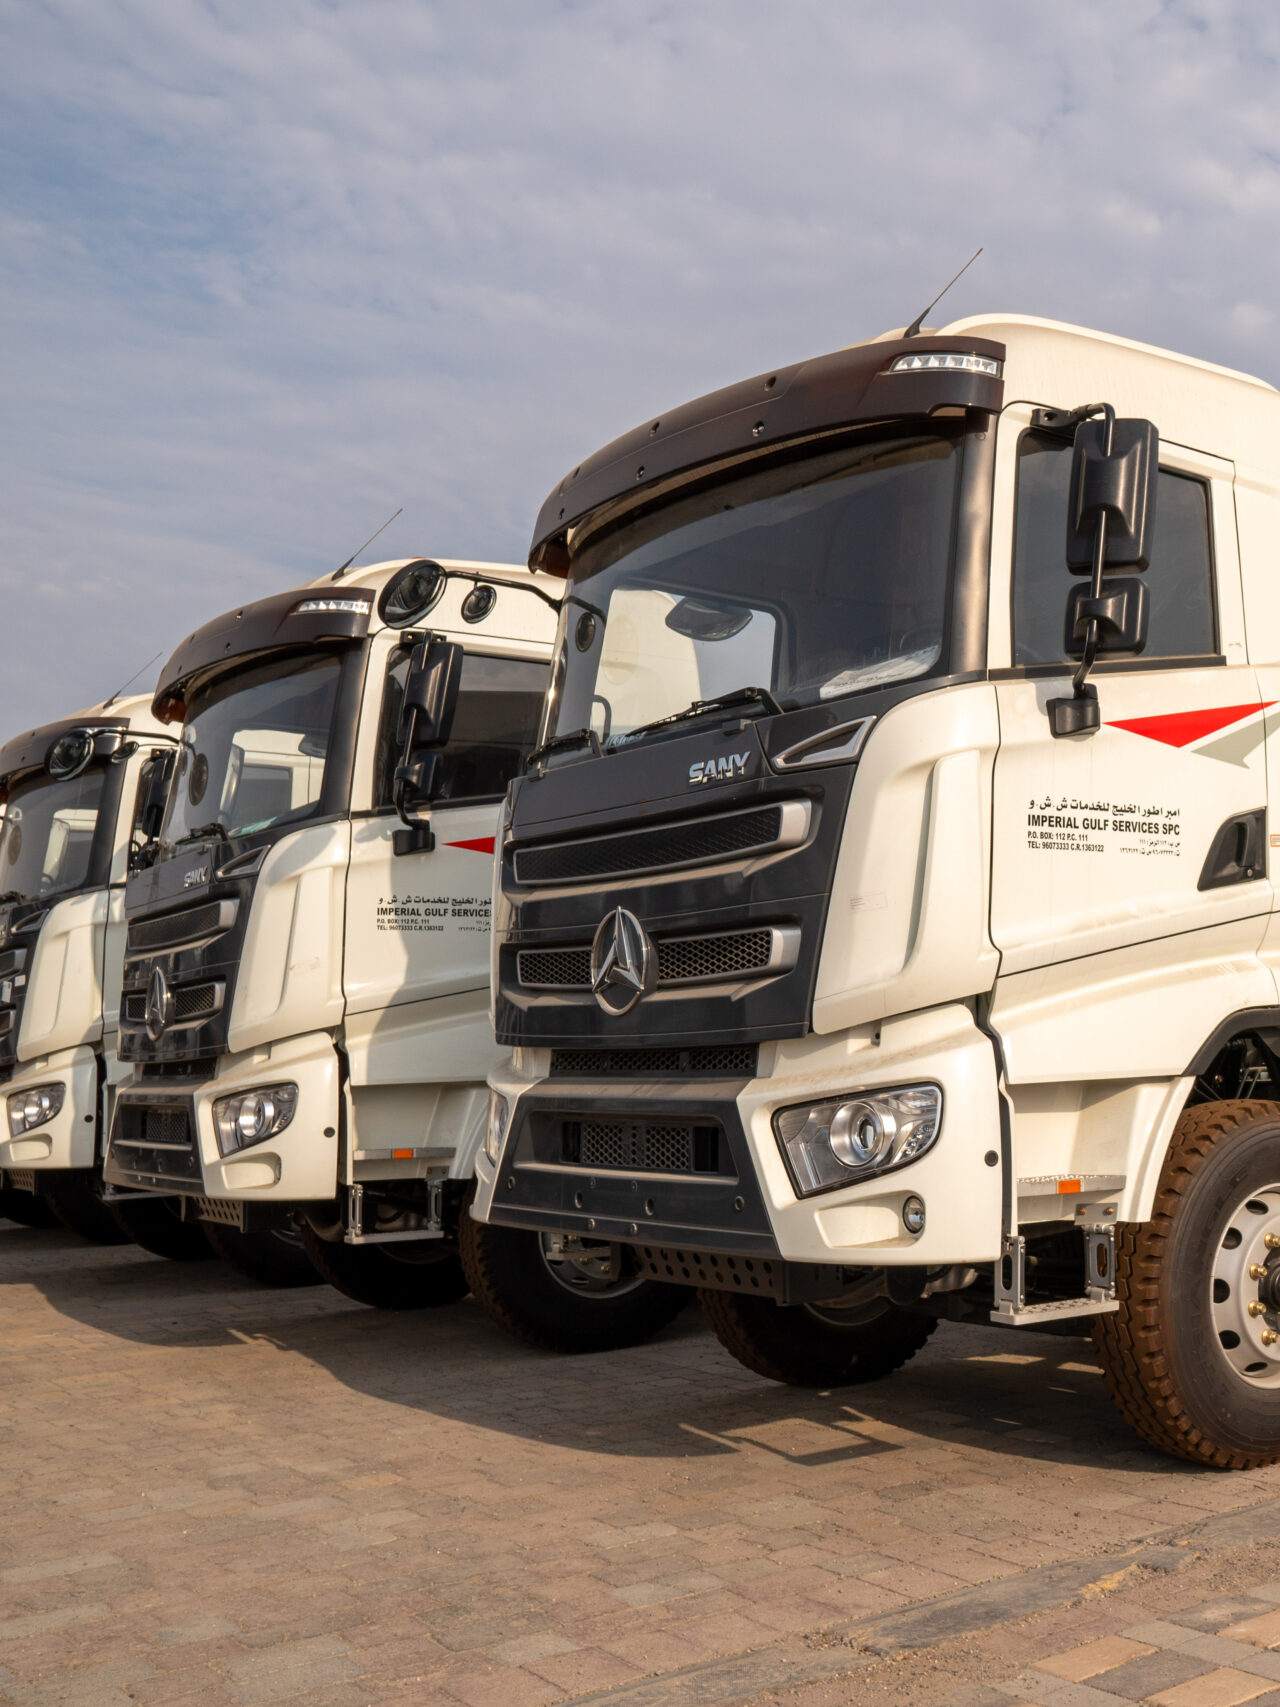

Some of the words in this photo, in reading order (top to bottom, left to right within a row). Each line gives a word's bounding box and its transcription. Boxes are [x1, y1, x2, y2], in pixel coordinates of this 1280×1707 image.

[689, 751, 751, 783] SANY
[1070, 799, 1110, 812] للخدمات
[1112, 803, 1140, 816] الخليج
[1027, 814, 1079, 829] IMPERIAL
[1082, 817, 1109, 831] GULF
[1112, 819, 1160, 834] SERVICES
[1162, 823, 1180, 836] SPC
[1027, 831, 1039, 840] P.O.
[1040, 831, 1054, 840] BOX:
[1055, 832, 1066, 841] 112
[1078, 834, 1088, 842] 111
[1027, 841, 1041, 849] TEL:
[1042, 841, 1069, 851] 96073333
[377, 907, 422, 917] IMPERIAL
[424, 908, 449, 917] GULF
[451, 908, 492, 918] SERVICE
